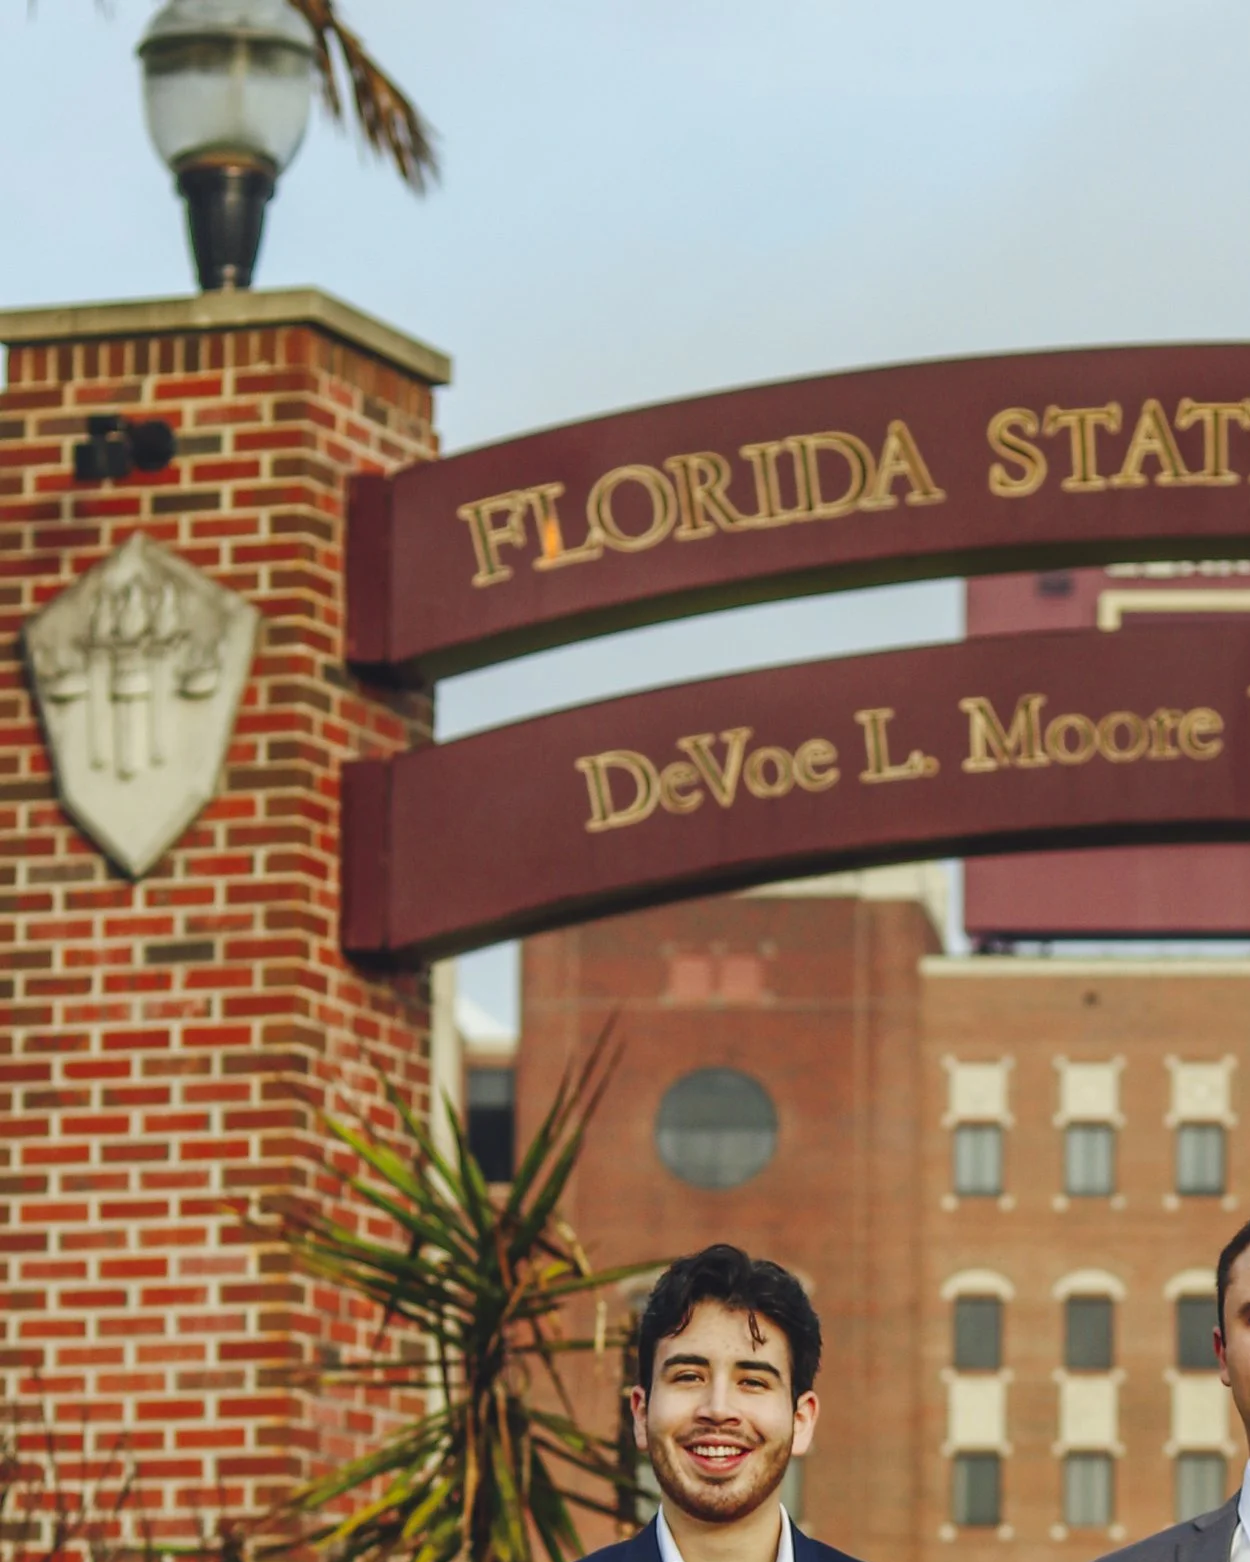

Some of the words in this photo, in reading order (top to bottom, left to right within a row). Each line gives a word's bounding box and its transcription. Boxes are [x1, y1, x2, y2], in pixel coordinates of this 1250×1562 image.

[457, 420, 945, 587] FLORIDA
[575, 726, 840, 831] DeVoe
[959, 694, 1224, 770] Moore
